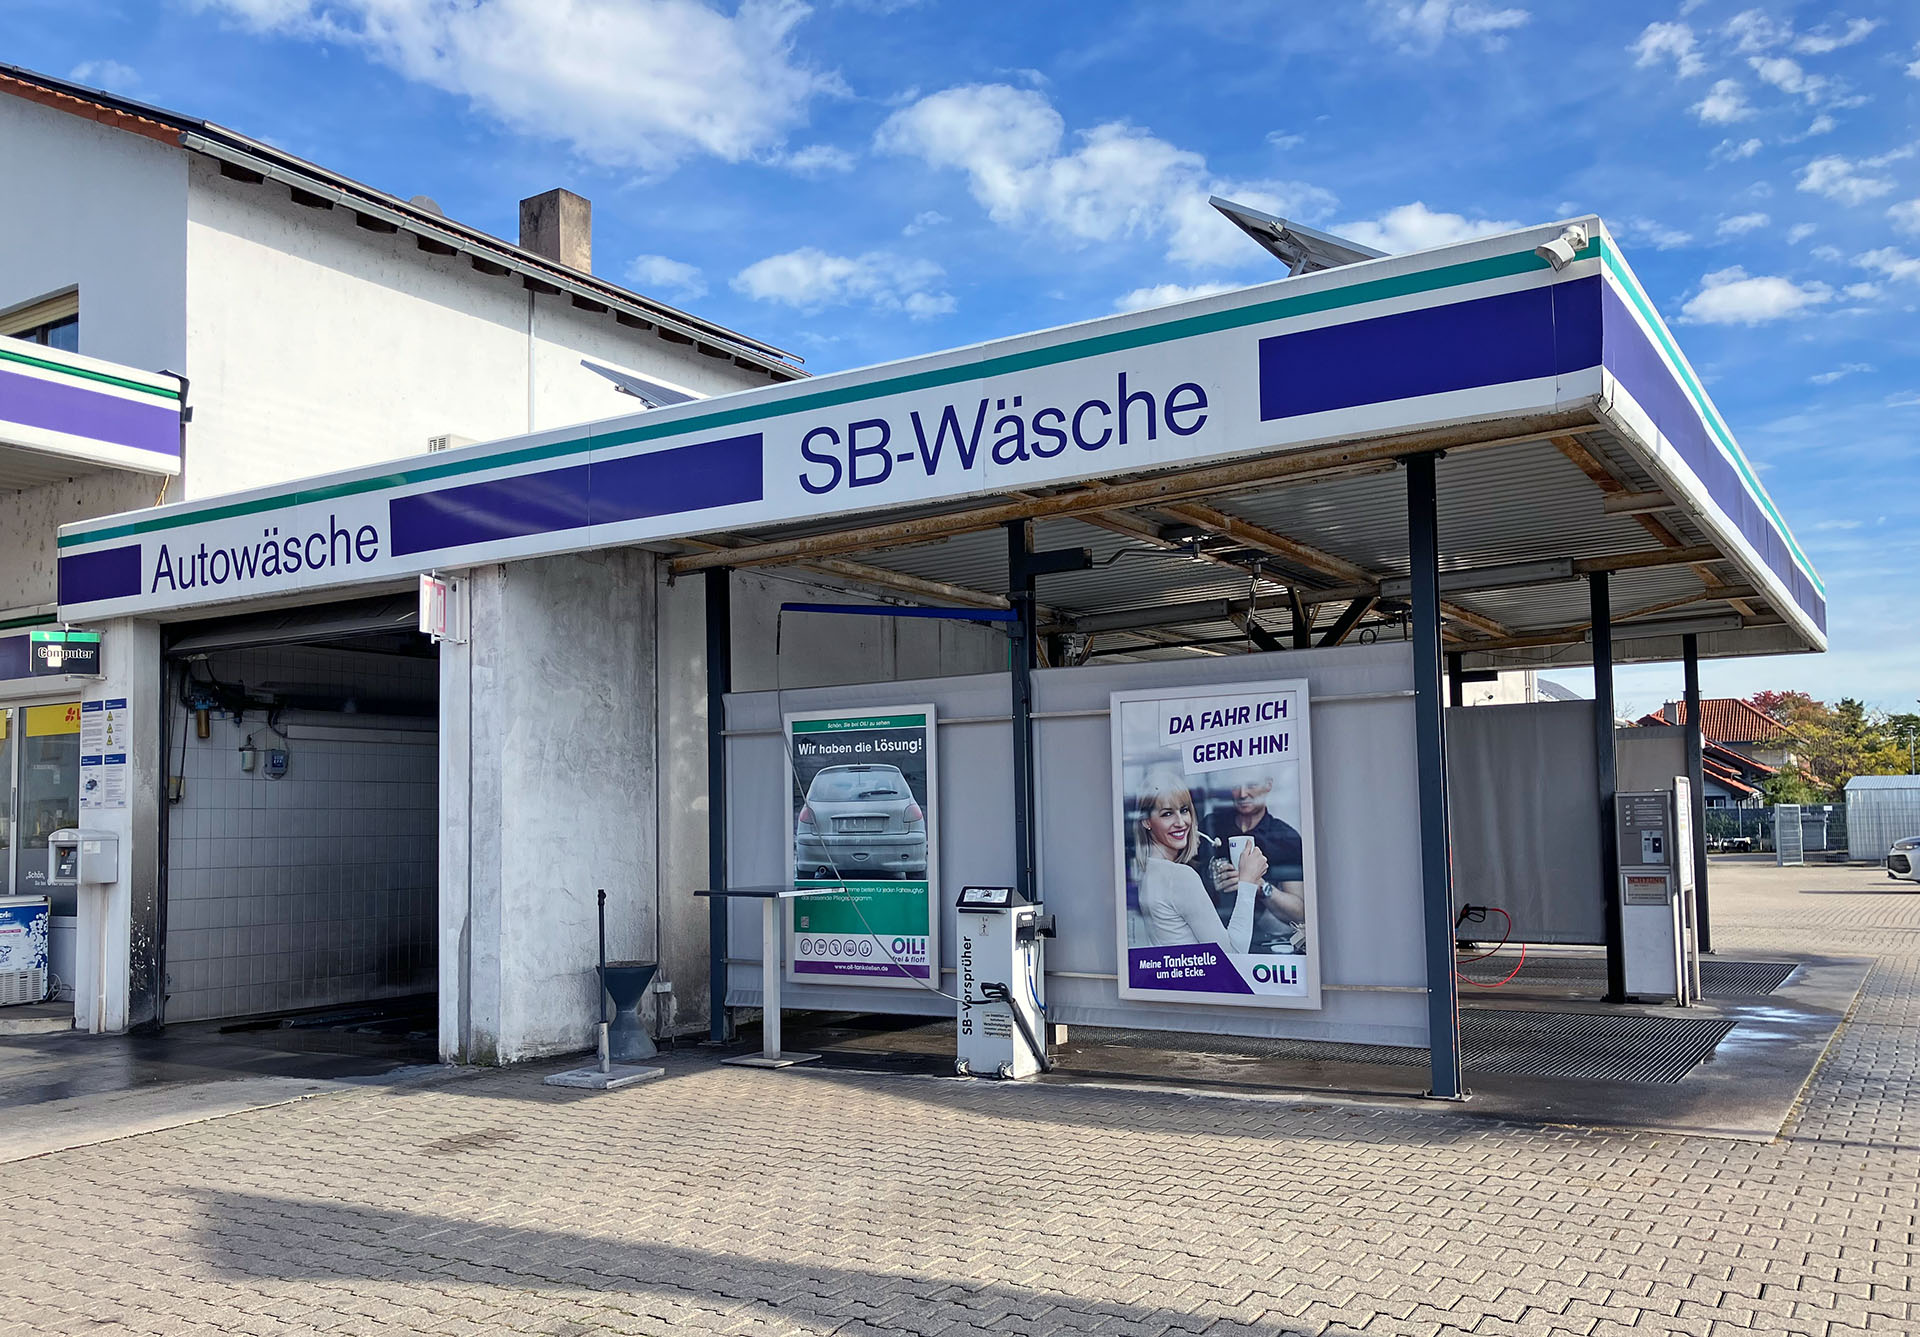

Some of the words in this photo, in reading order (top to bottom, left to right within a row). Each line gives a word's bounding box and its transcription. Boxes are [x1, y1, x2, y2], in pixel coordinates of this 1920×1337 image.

[799, 371, 1208, 495] SB-Wäsche
[151, 514, 379, 594] Autowäsche
[37, 646, 94, 660] Computer
[1169, 715, 1195, 734] DA
[1200, 706, 1251, 730] FAHR
[1255, 700, 1287, 722] ICH
[798, 743, 816, 755] Wir
[819, 744, 852, 754] haben
[855, 742, 872, 753] die
[874, 738, 922, 753] Lösung!
[1193, 739, 1243, 764] GERN
[1249, 733, 1289, 756] HIN!
[891, 937, 925, 955] OIL!
[1139, 960, 1162, 969] Meine
[1163, 952, 1217, 968] Tankstelle
[1156, 971, 1169, 979] um
[1170, 969, 1183, 978] die
[1184, 967, 1206, 977] Ecke.
[1252, 964, 1297, 984] OIL!
[961, 936, 975, 1035] SB-Vorsprüher
